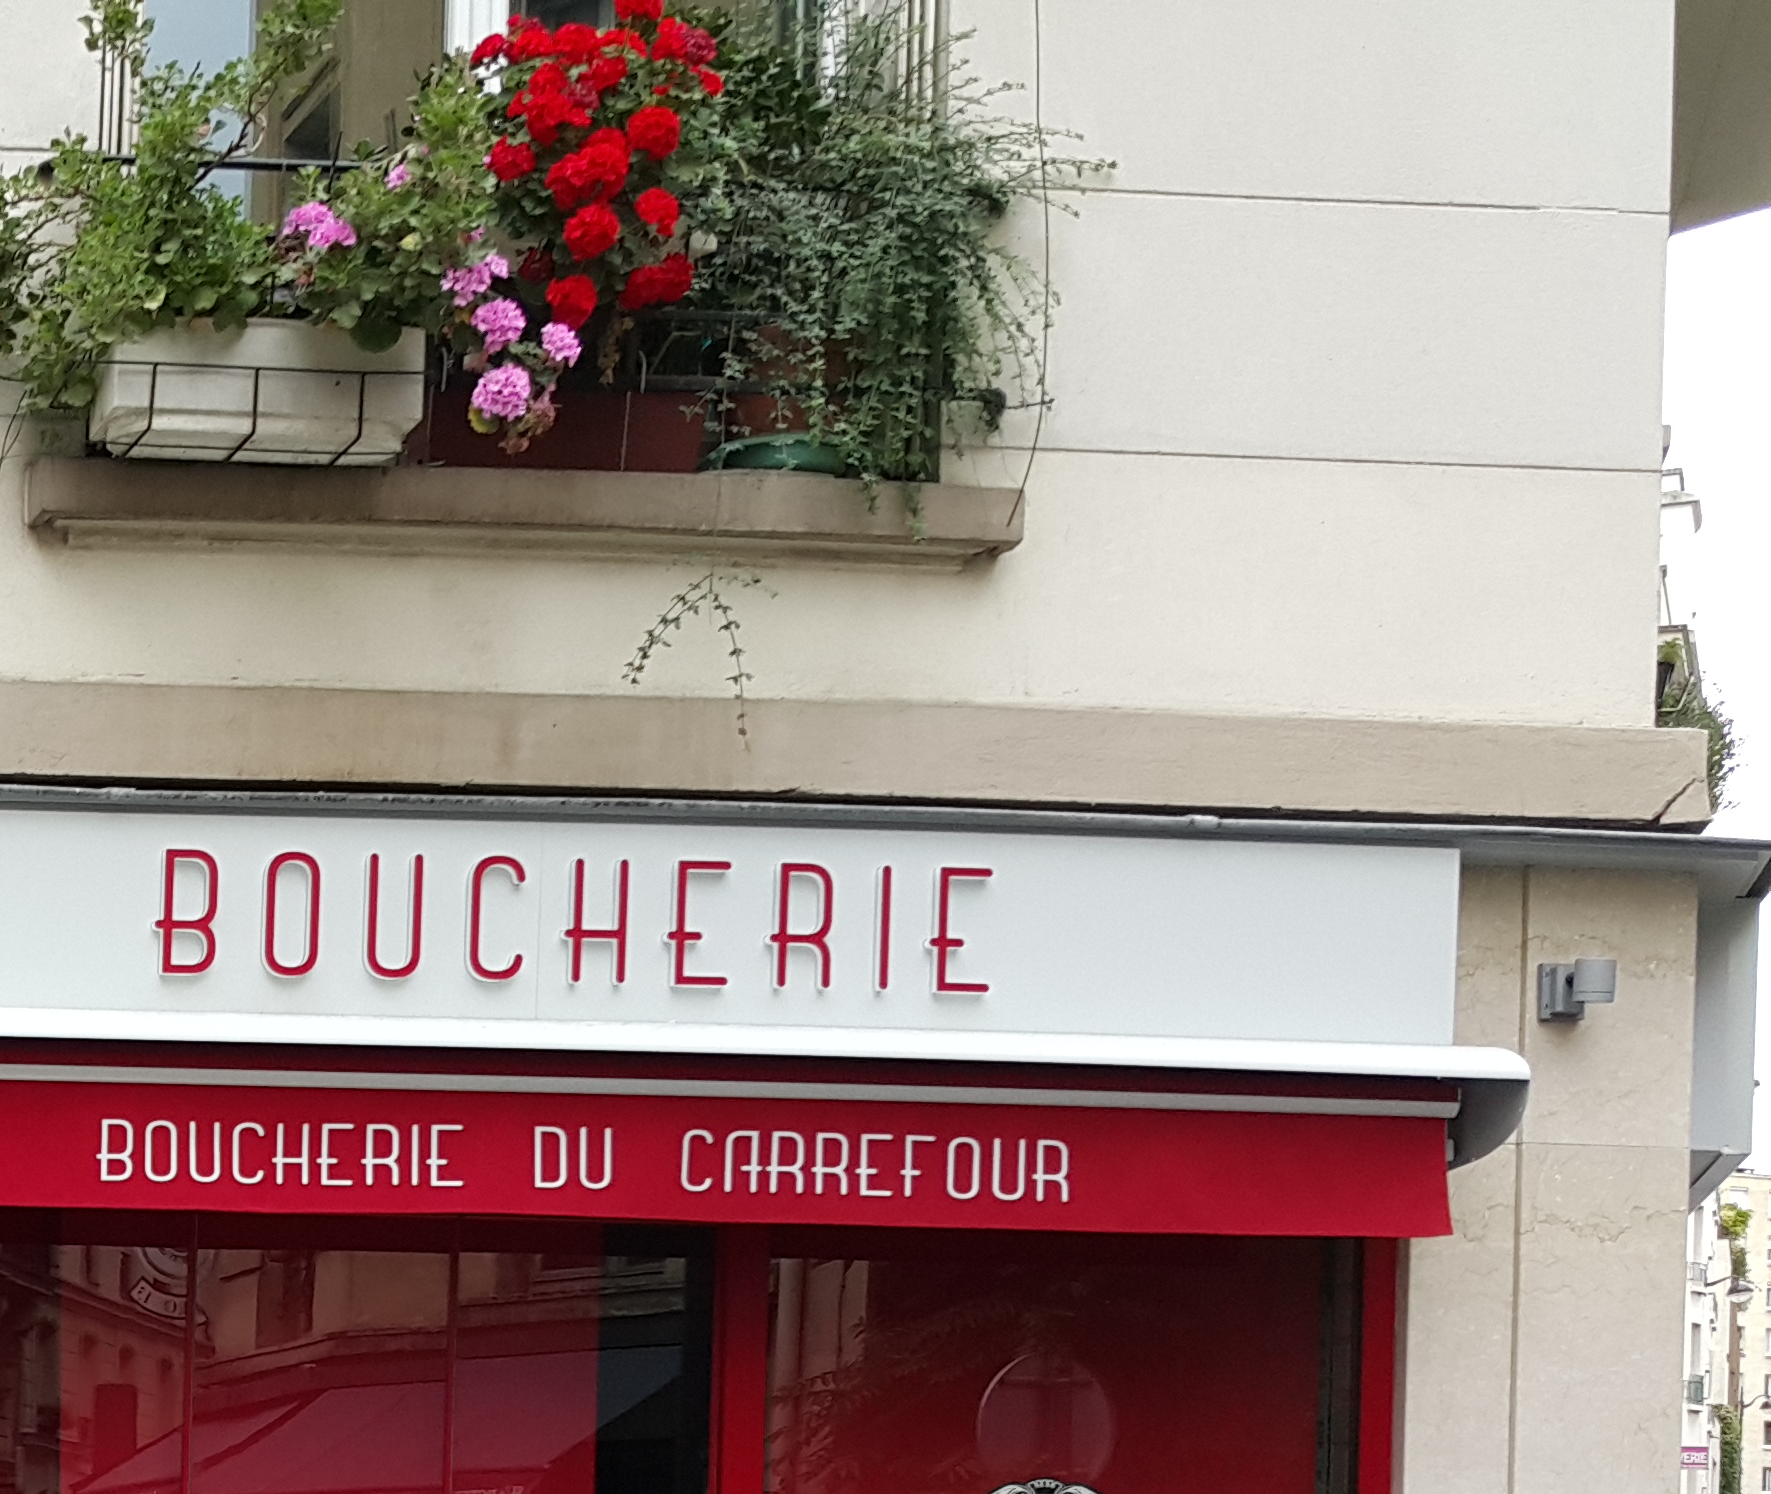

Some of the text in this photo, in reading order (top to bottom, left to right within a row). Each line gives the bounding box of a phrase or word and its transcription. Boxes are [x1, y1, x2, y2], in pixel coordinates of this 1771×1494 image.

[152, 847, 995, 997] BOUCHERIE
[96, 1117, 1072, 1203] BOUCHERIE DU CARREFOUR
